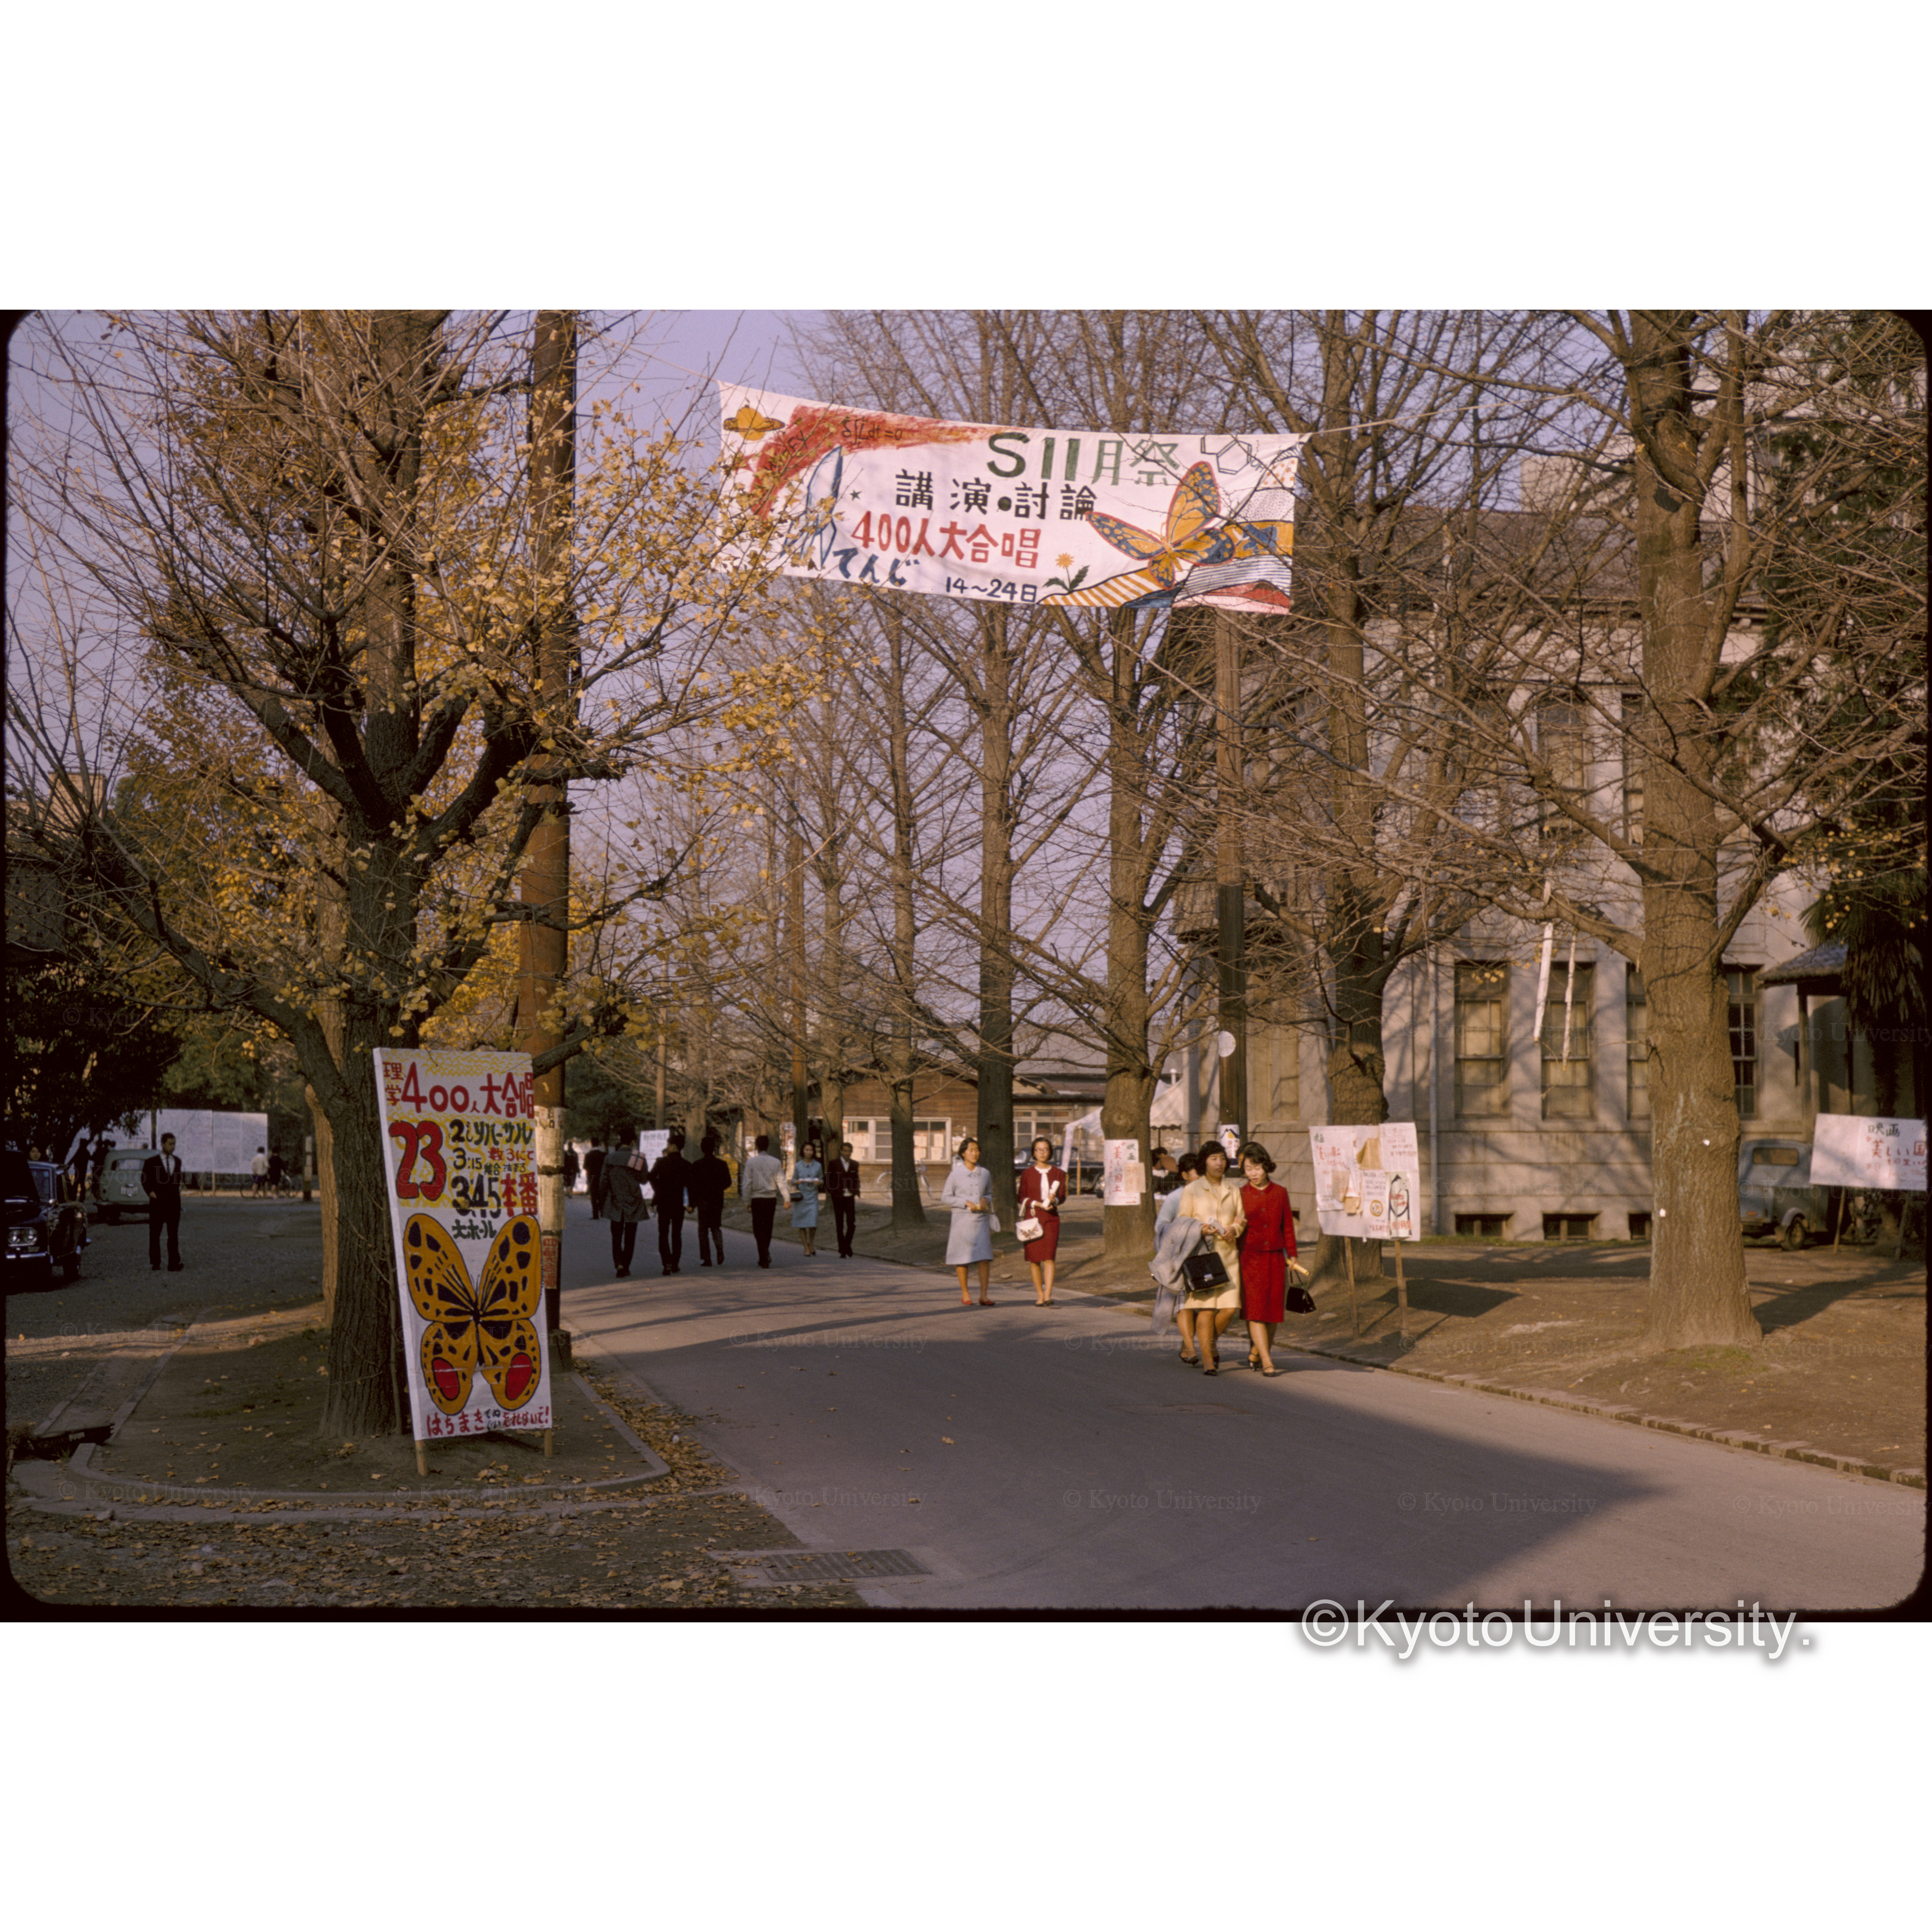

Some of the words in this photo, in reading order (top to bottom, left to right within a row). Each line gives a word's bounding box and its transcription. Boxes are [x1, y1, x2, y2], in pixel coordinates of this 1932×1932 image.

[851, 510, 1041, 569] 400人大合唱
[831, 545, 922, 587] てんじ
[383, 1061, 404, 1107] 理学
[1868, 1122, 1901, 1137] 映画
[388, 1119, 447, 1202] 23
[452, 1147, 482, 1170] 3:15
[501, 1172, 539, 1218] 本番
[451, 1219, 497, 1240] 大ホール
[427, 1409, 485, 1437] はちまき
